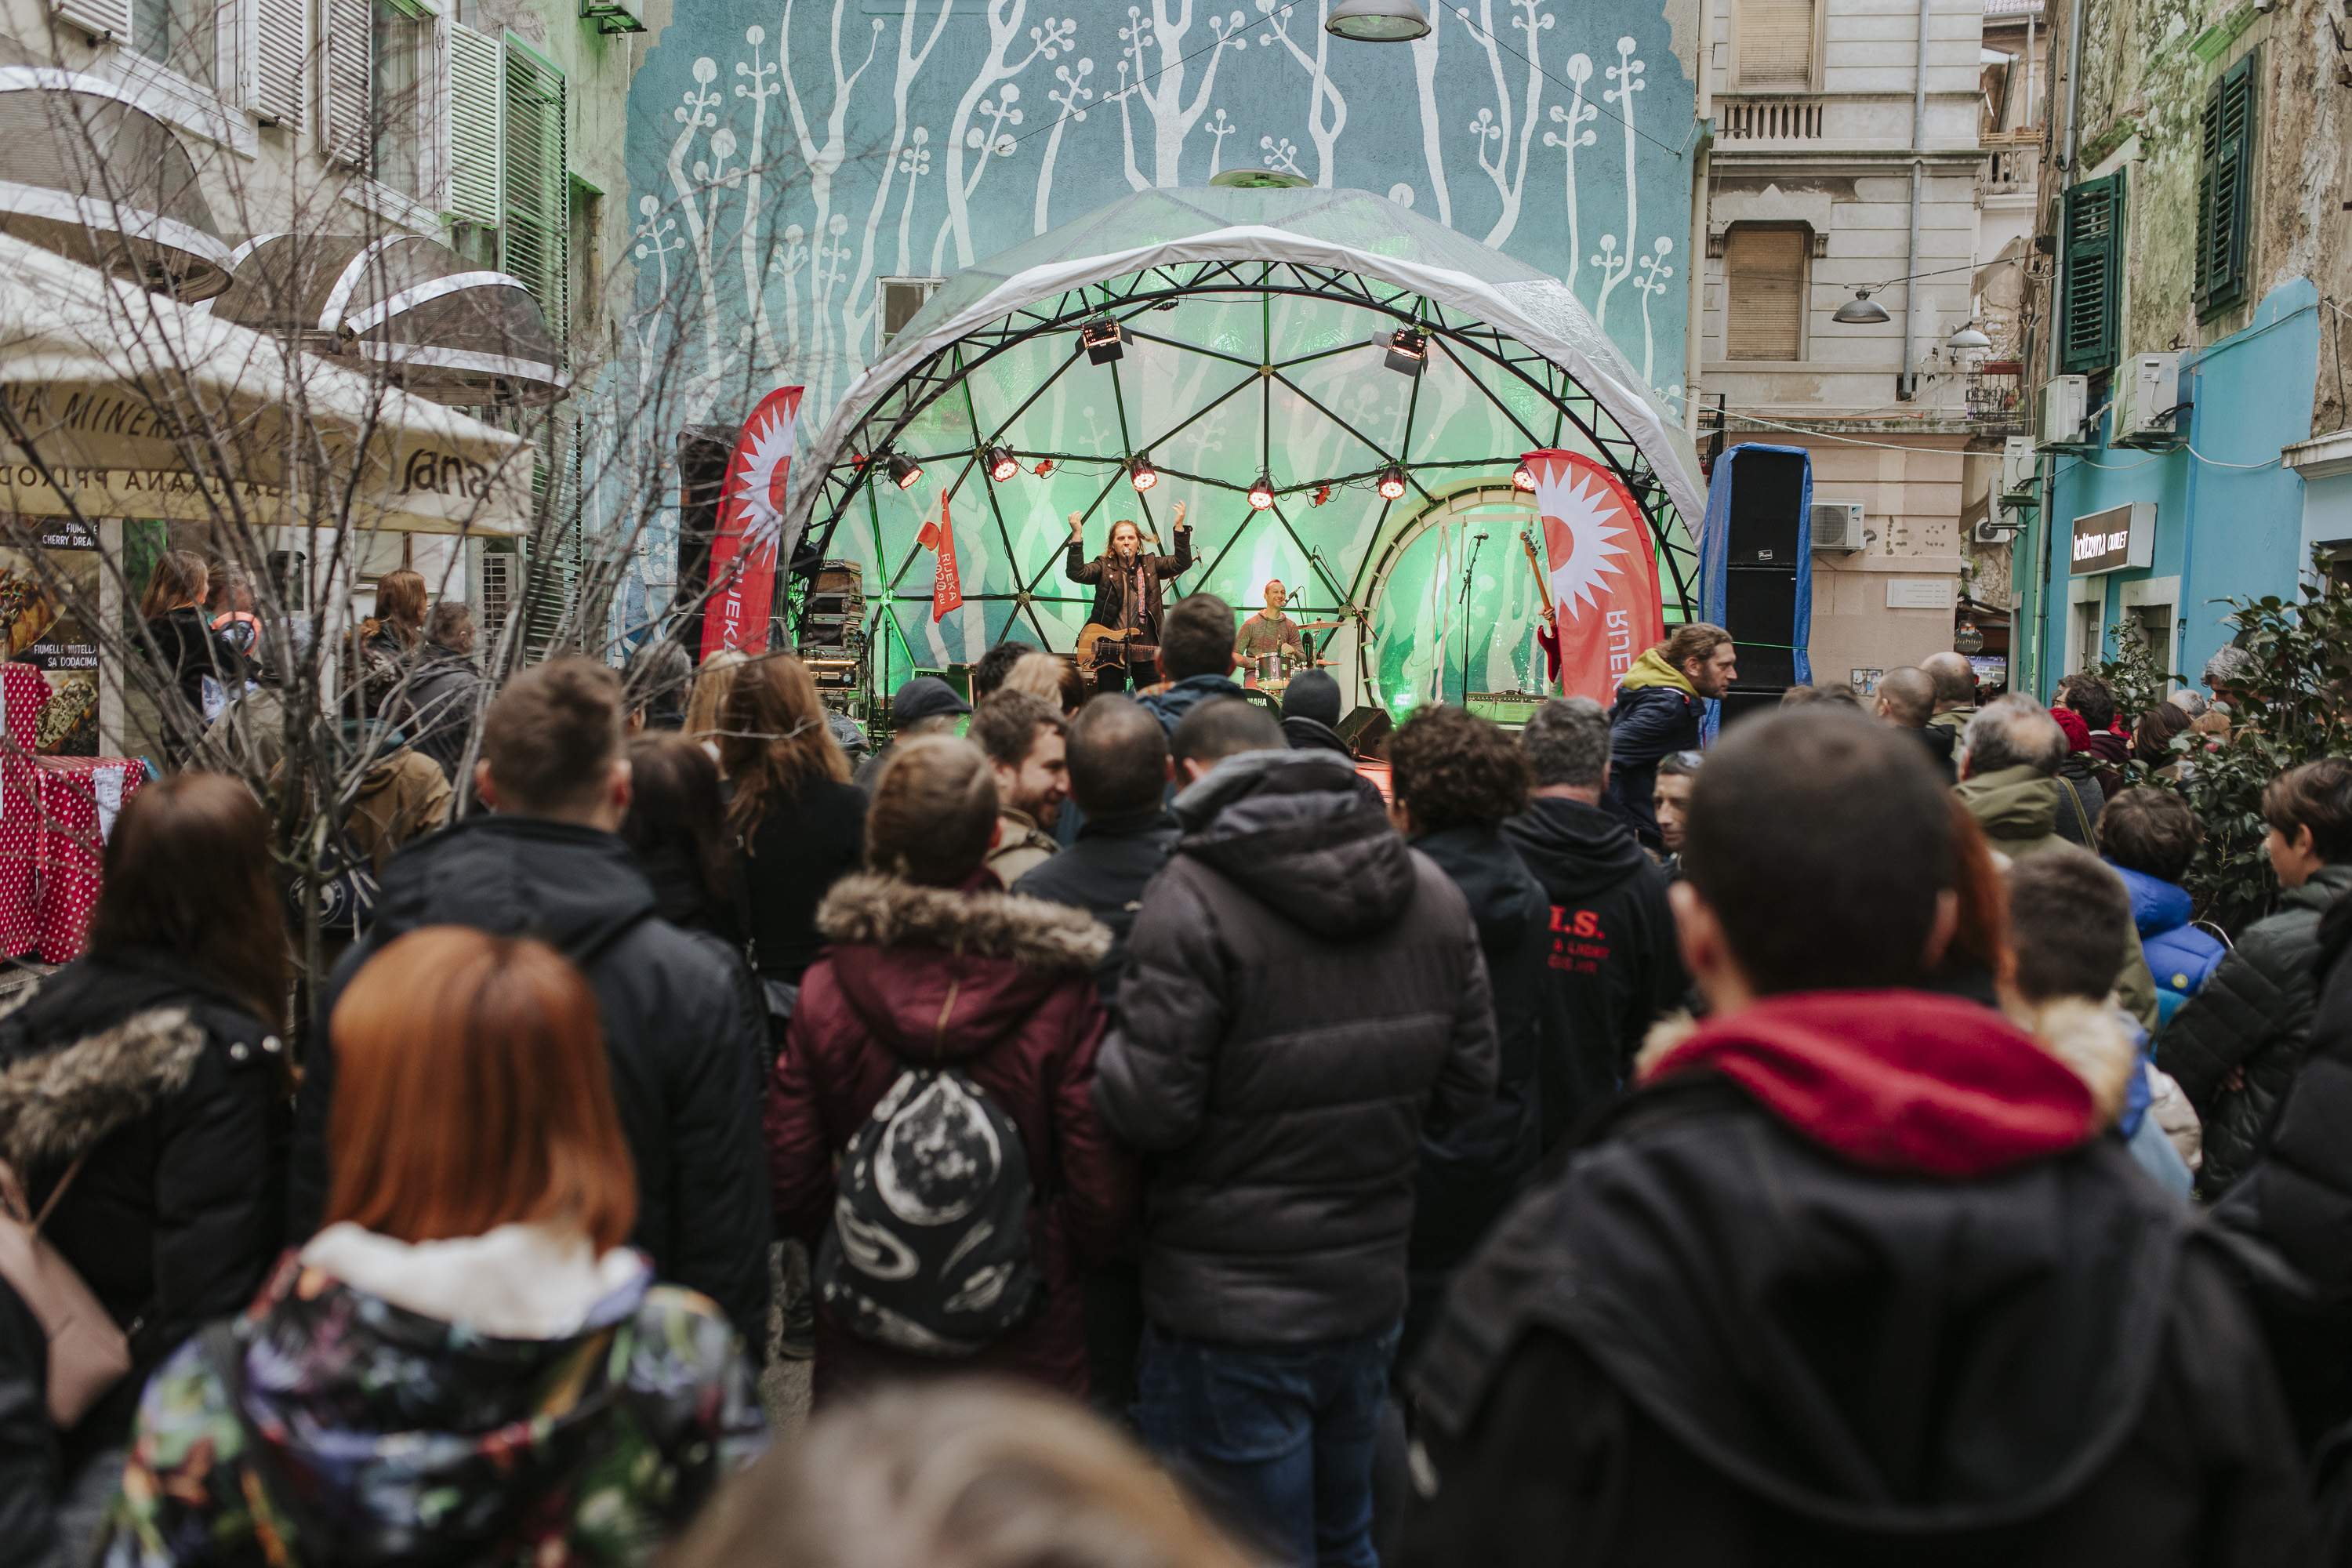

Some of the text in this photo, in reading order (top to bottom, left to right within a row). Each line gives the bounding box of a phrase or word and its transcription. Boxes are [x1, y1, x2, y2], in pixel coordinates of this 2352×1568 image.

[42, 534, 95, 546] CHERRY DREA
[941, 553, 956, 601] RIJEKA
[48, 657, 98, 667] SA DODACIMA
